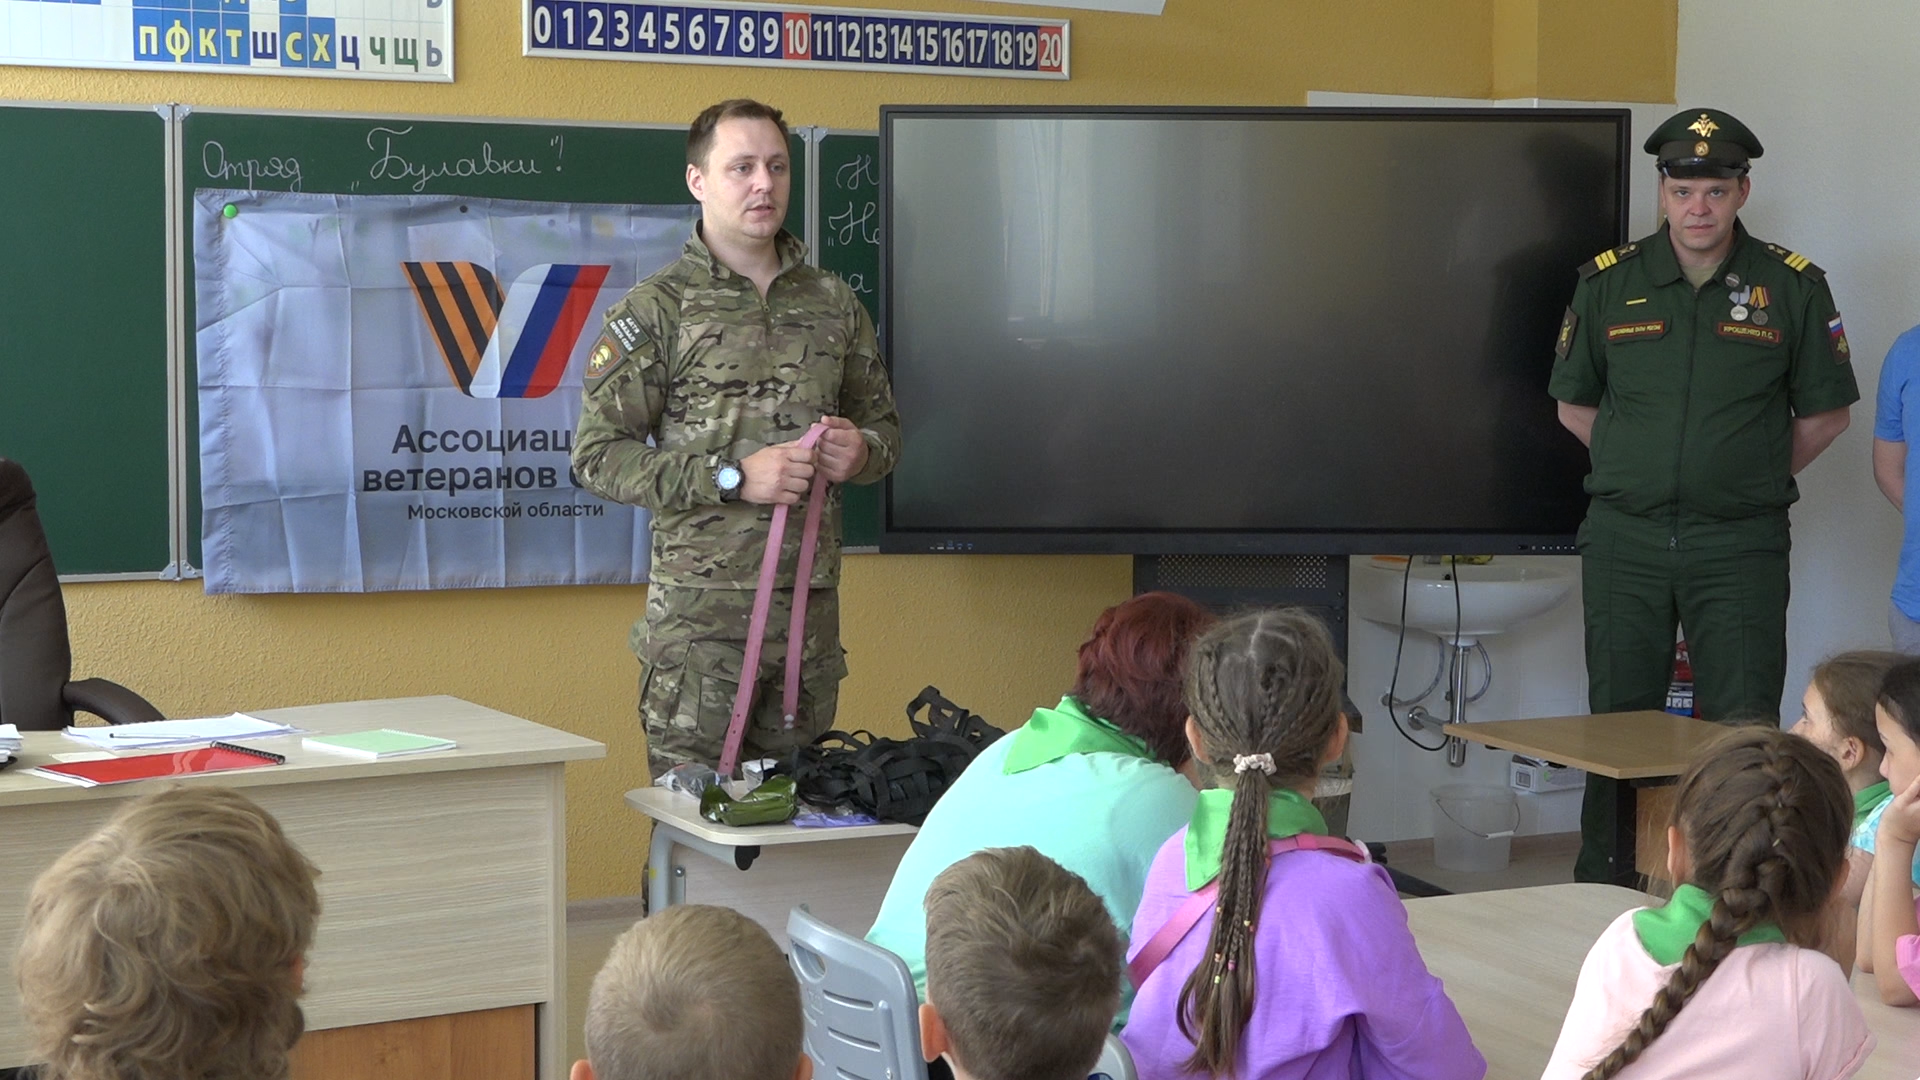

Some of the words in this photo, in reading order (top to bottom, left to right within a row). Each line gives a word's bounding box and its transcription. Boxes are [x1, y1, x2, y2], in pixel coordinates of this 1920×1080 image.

[533, 6, 552, 44] 0
[562, 8, 575, 45] 1
[587, 9, 604, 46] 2
[613, 10, 630, 47] 3
[638, 12, 656, 48] 4
[664, 13, 681, 49] 5
[688, 14, 706, 51] 6
[714, 15, 730, 51] 7
[739, 16, 756, 53] 8
[762, 17, 780, 54] 9
[785, 19, 809, 54] 10
[813, 20, 833, 57] 11
[838, 21, 861, 58] 12
[865, 23, 887, 59] 13
[890, 24, 914, 60] 14
[916, 26, 939, 61] 15
[942, 27, 965, 63] 16
[966, 28, 989, 64] 17
[991, 30, 1013, 65] 18
[1015, 31, 1038, 66] 19
[1040, 32, 1062, 68] 20
[203, 140, 303, 193] Отряд
[391, 424, 573, 456] Ассоциац
[362, 465, 557, 497] ветеранов
[408, 502, 522, 520] Московской
[527, 501, 604, 518] области
